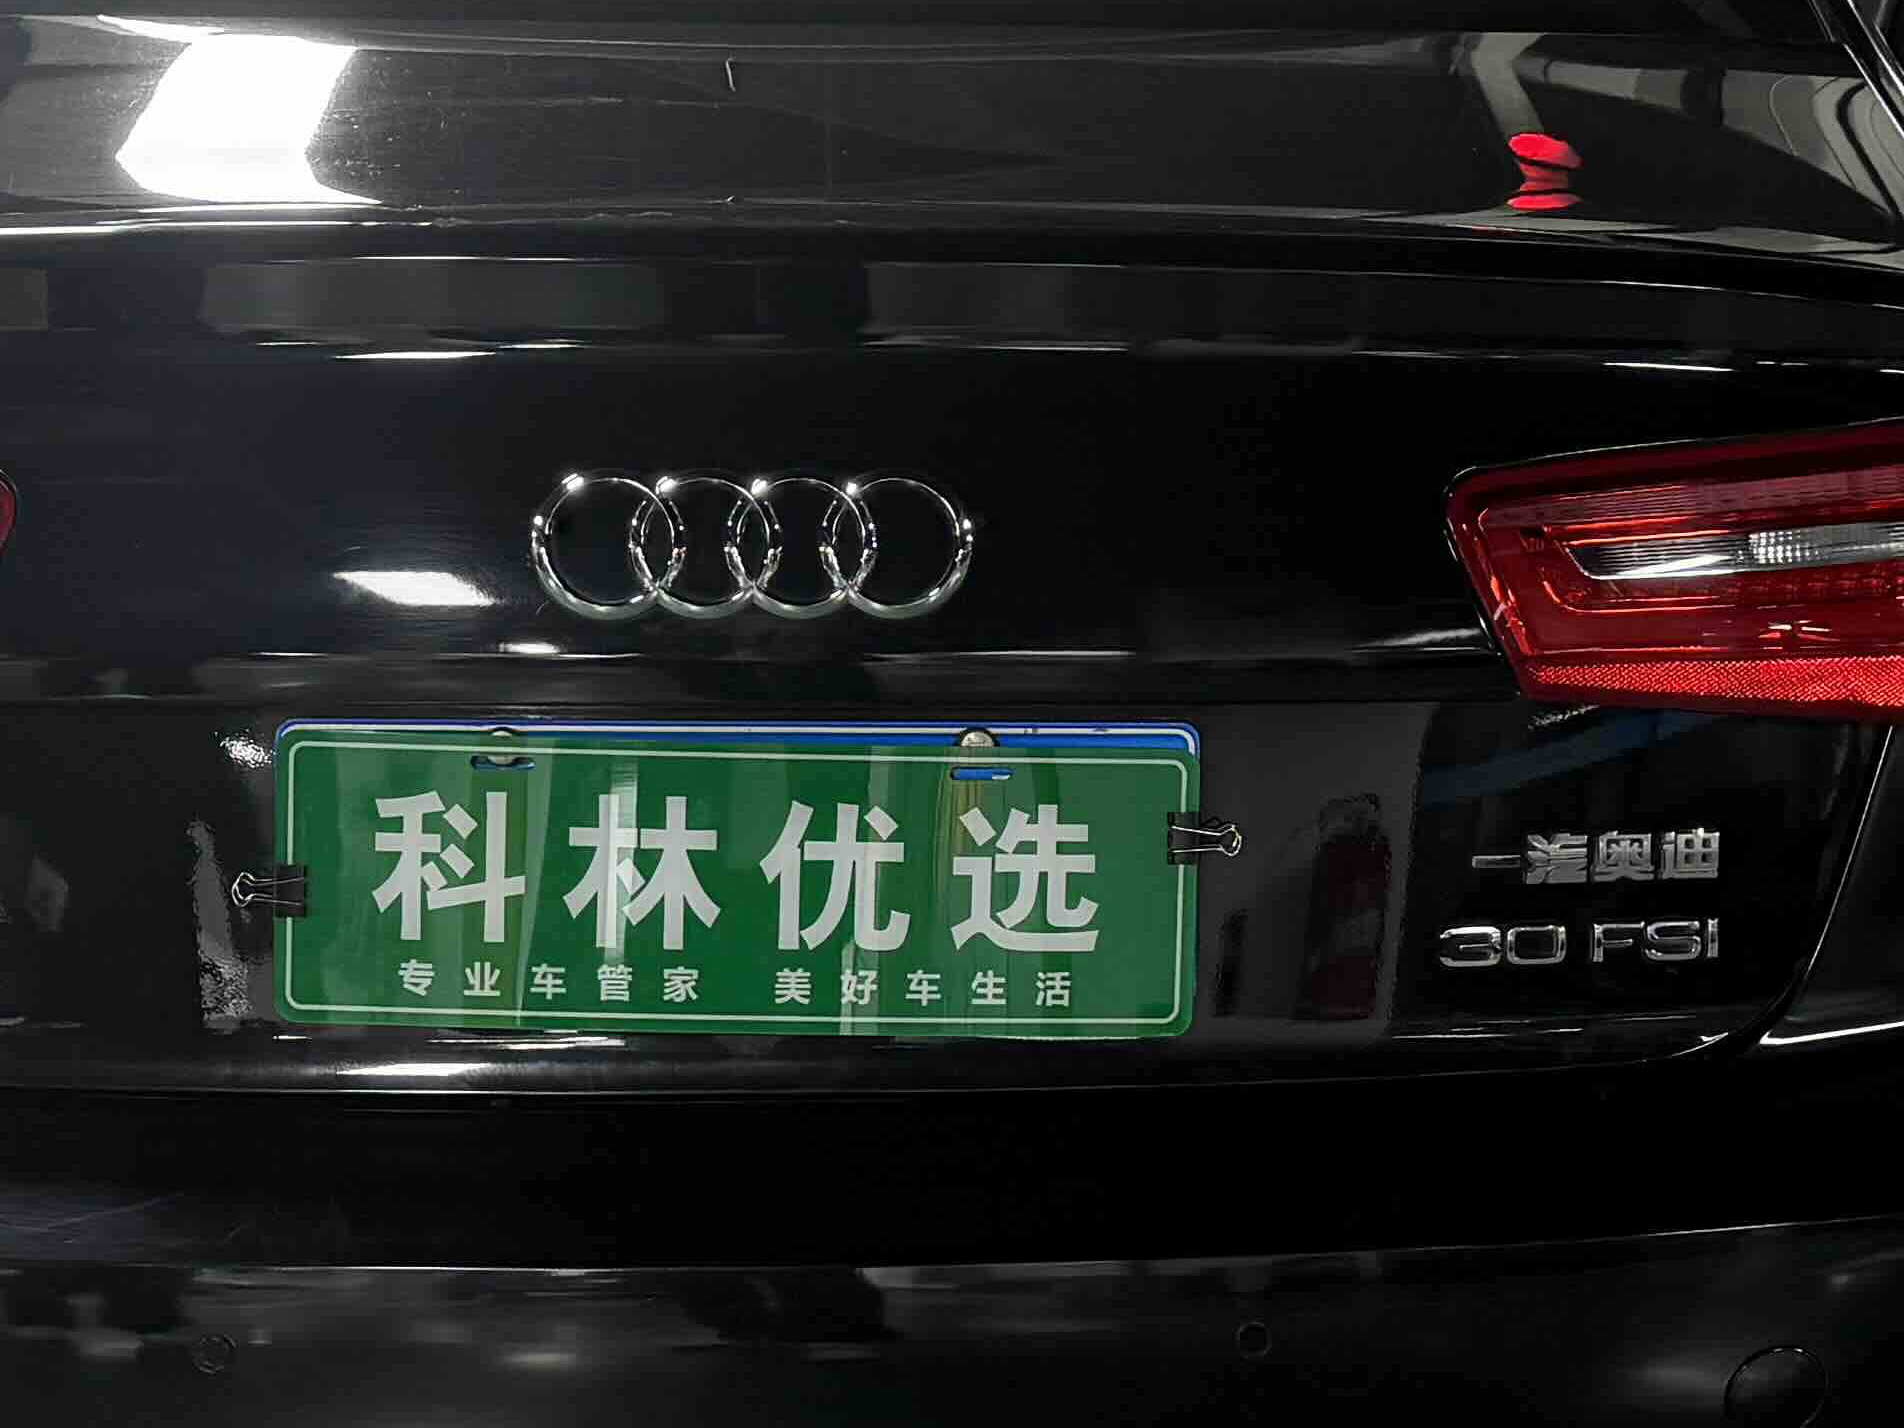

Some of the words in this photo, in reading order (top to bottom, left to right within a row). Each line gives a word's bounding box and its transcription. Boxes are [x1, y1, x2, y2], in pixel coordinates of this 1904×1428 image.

[372, 790, 1099, 952] 科林优选
[1471, 827, 1721, 885] 一汽奥迪
[1439, 925, 1567, 968] 30
[1592, 918, 1720, 964] FSI
[397, 959, 700, 1004] 专业车管家
[773, 967, 1072, 1008] 美好车生活
